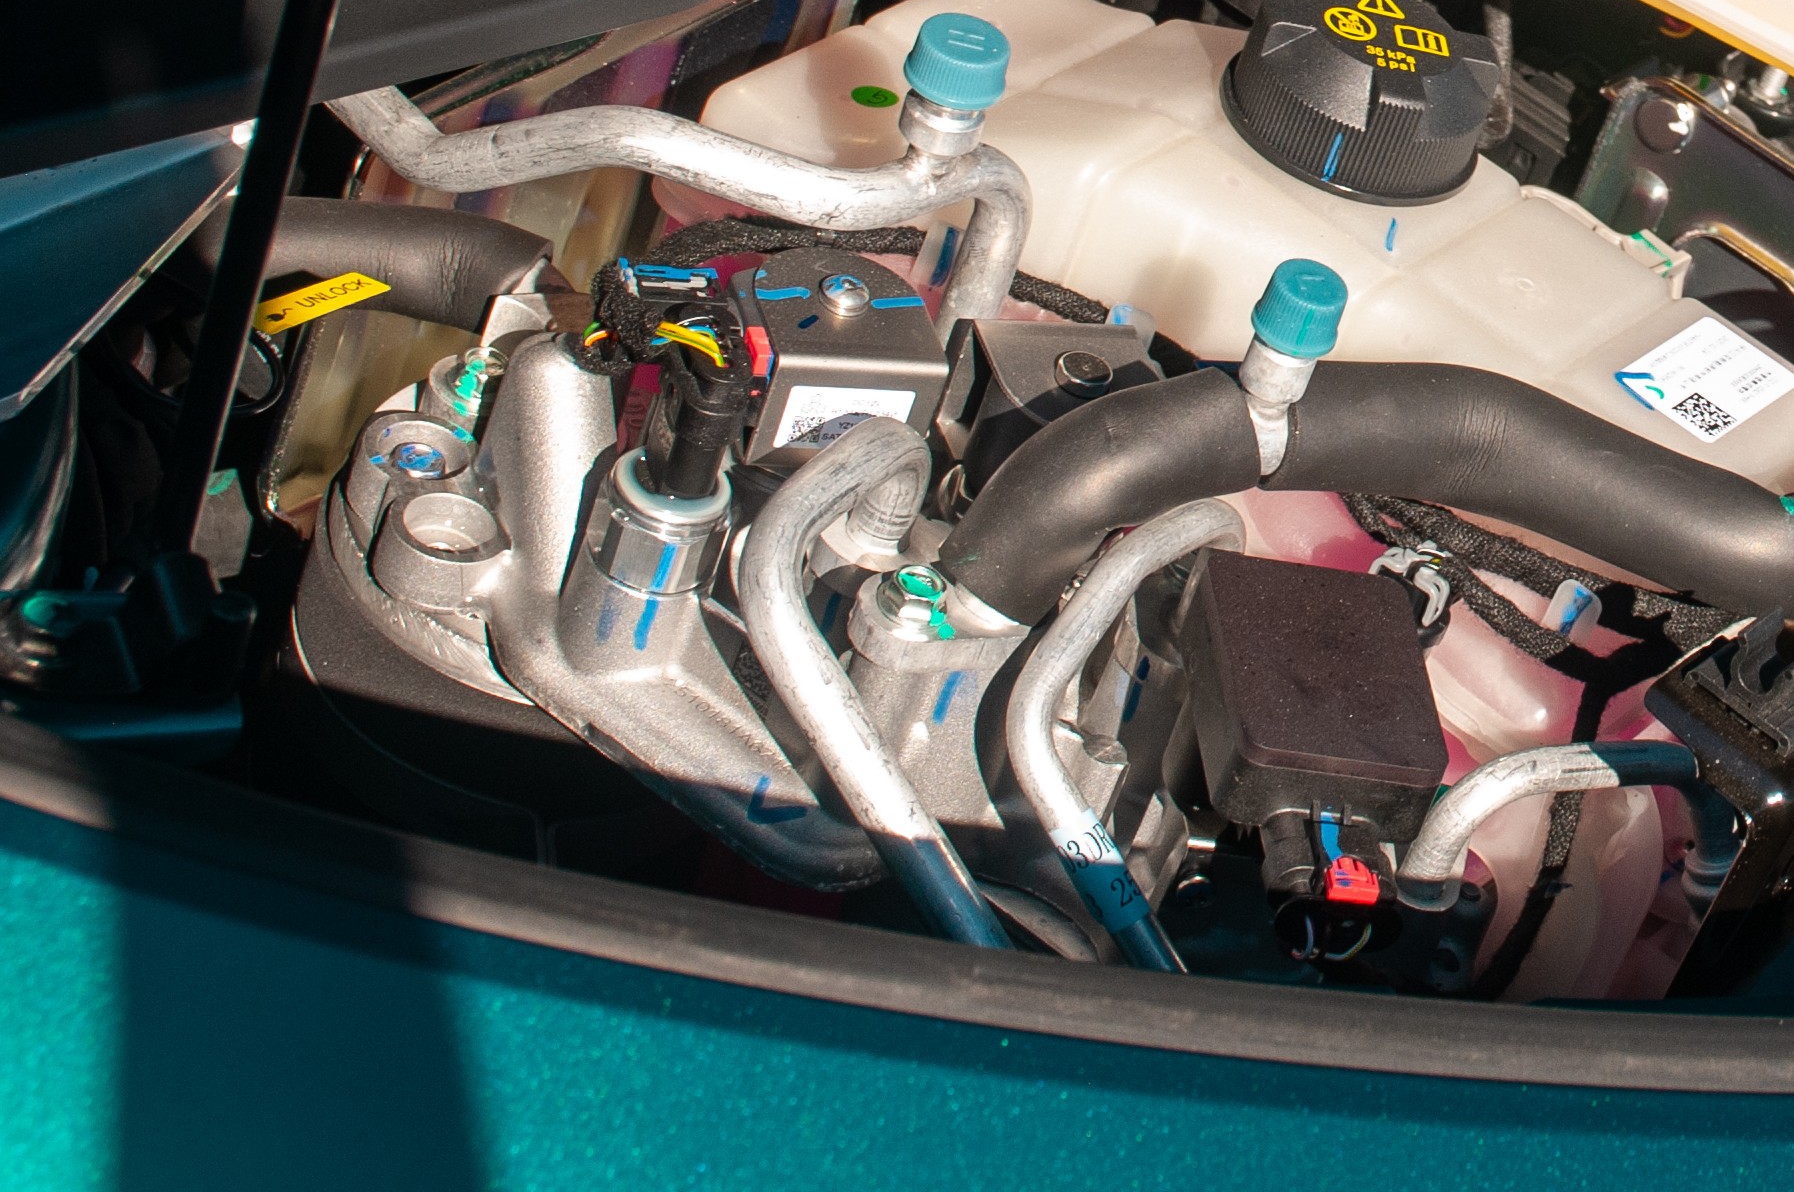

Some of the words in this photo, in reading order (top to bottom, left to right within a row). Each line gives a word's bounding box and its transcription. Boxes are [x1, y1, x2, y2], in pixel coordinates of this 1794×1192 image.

[1365, 44, 1385, 57] 35
[1387, 49, 1416, 64] kPa
[1389, 60, 1415, 73] psi
[295, 278, 371, 308] UNLOCK
